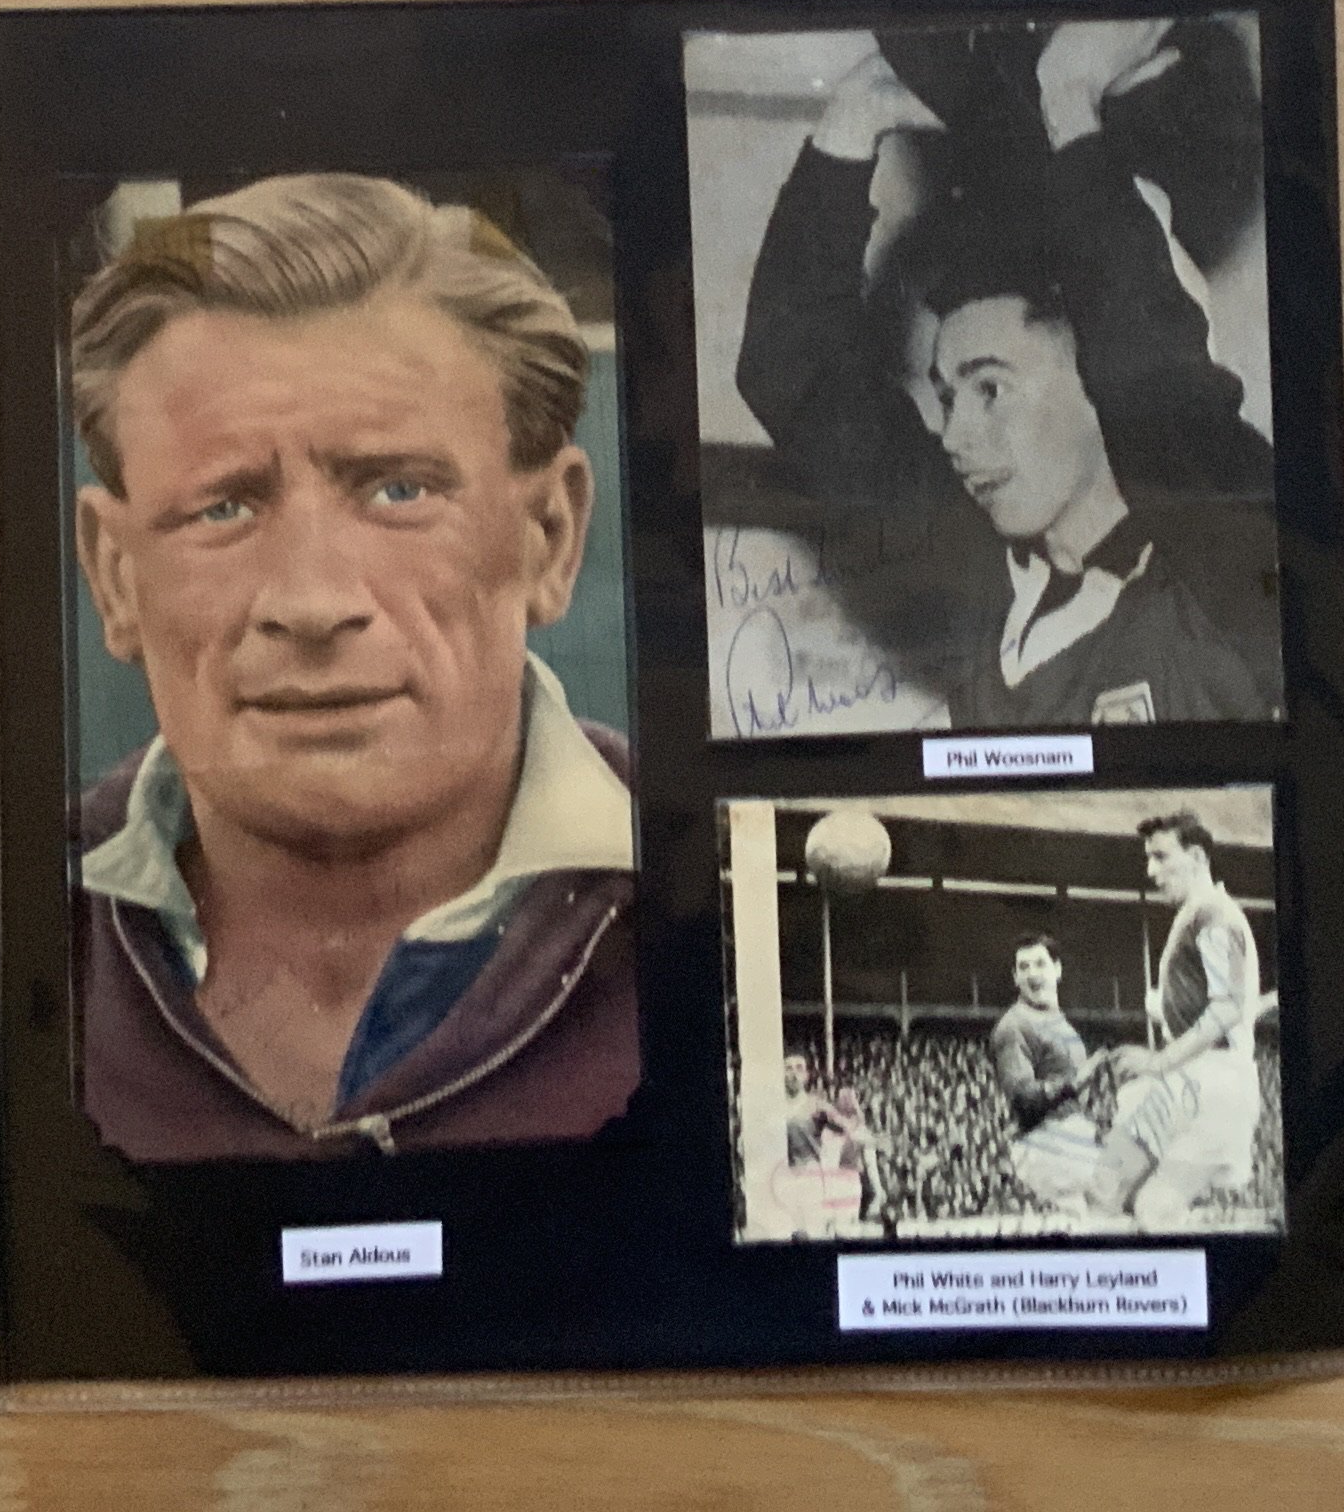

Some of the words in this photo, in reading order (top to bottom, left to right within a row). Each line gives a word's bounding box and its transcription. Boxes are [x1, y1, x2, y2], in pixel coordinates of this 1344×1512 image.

[947, 751, 978, 768] Phil
[983, 751, 1074, 767] Woosnam
[301, 1250, 342, 1267] Stan
[349, 1246, 410, 1266] Aldous
[893, 1271, 924, 1288] Phil
[930, 1271, 984, 1288] White
[990, 1271, 1025, 1287] and
[1030, 1270, 1079, 1292] Harry
[1086, 1269, 1158, 1291] Leyland
[862, 1299, 875, 1315] &
[882, 1298, 922, 1314] Mick
[929, 1297, 1005, 1314] McGrath
[1012, 1296, 1110, 1316] (Blackburn
[1116, 1296, 1188, 1316] Rovers)
